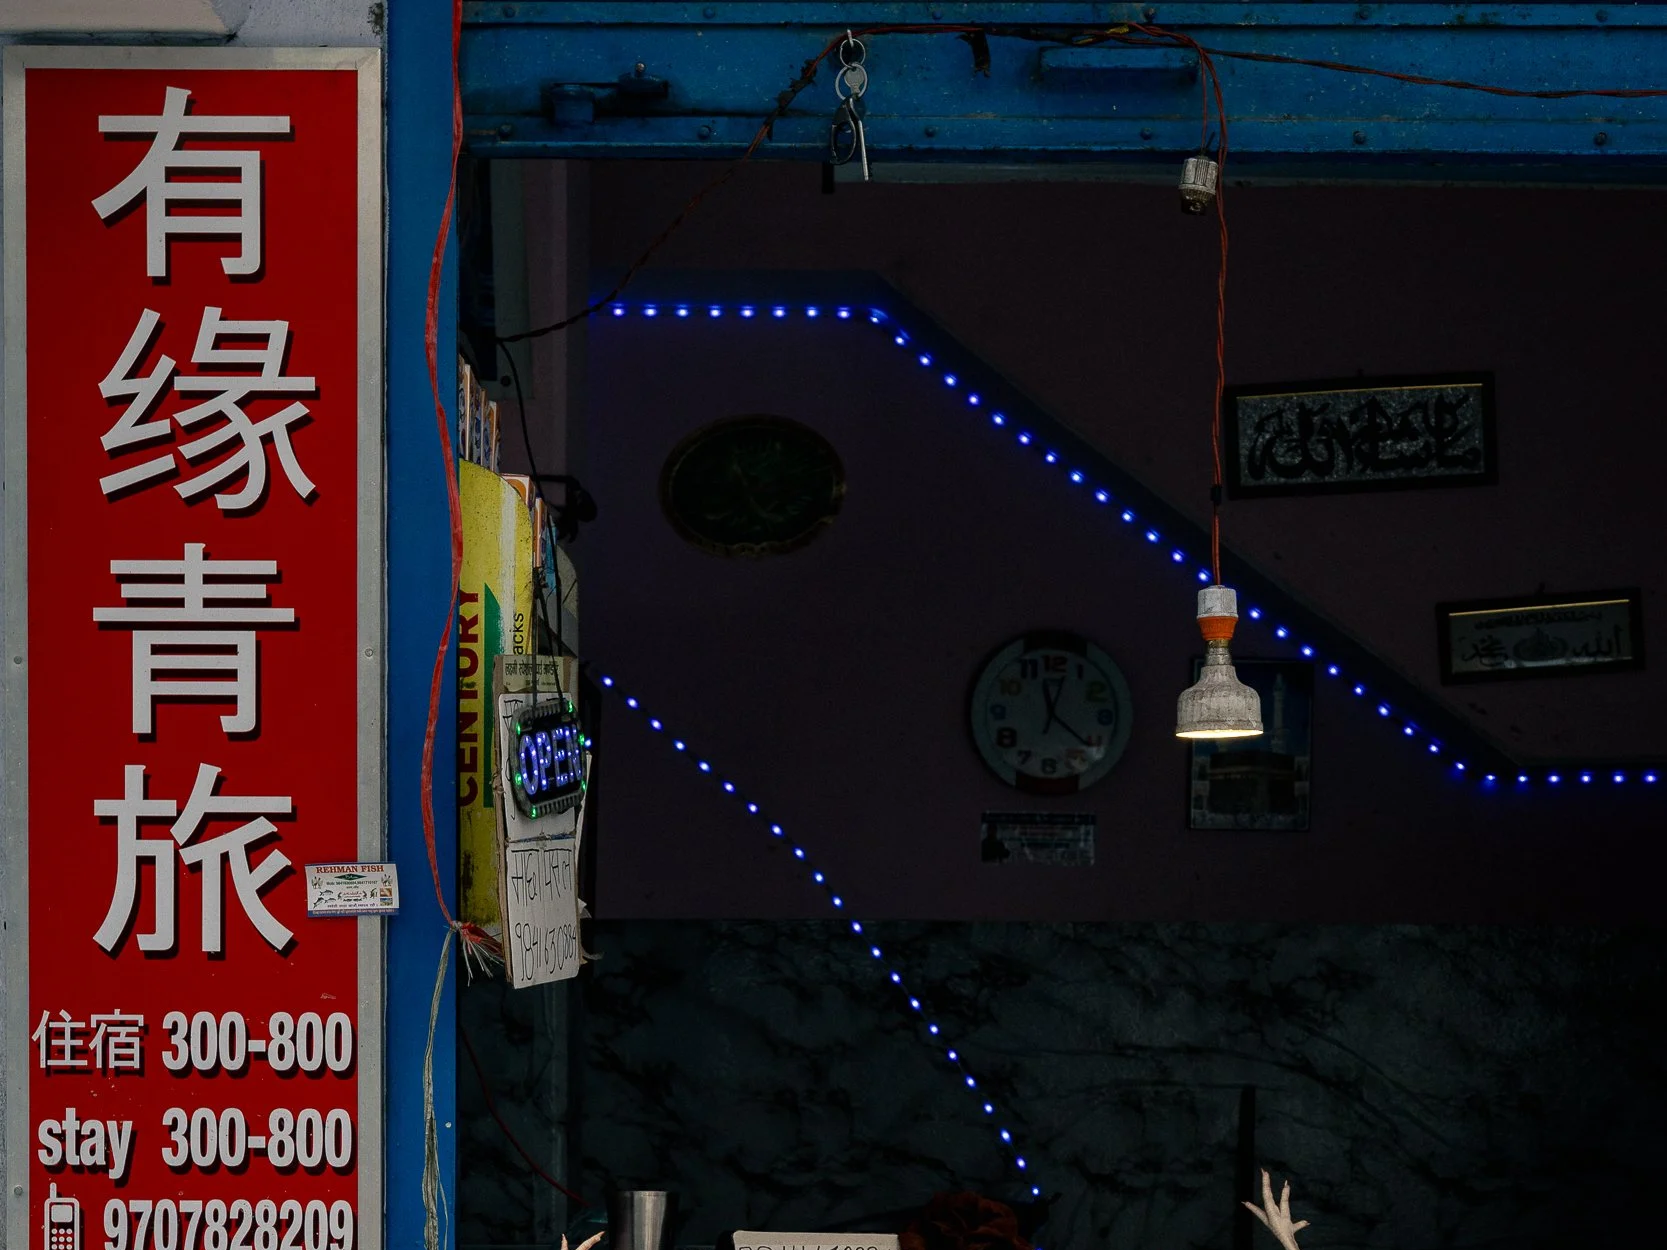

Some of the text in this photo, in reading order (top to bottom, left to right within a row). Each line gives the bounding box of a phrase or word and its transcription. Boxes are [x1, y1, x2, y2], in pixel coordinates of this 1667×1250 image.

[91, 86, 316, 953] 有缘青旅
[513, 613, 525, 655] acks
[1018, 658, 1039, 679] 11
[1043, 655, 1067, 673] 12
[999, 678, 1021, 696] 10
[1086, 681, 1108, 702] 2
[990, 704, 1007, 720] 9
[997, 727, 1017, 748] 8
[519, 725, 584, 796] OPEN
[1016, 750, 1032, 765] 7
[1041, 758, 1058, 774] 6
[361, 865, 384, 873] FISH
[32, 1009, 352, 1072] 住宿 300-800
[38, 1107, 352, 1179] stay 300-800
